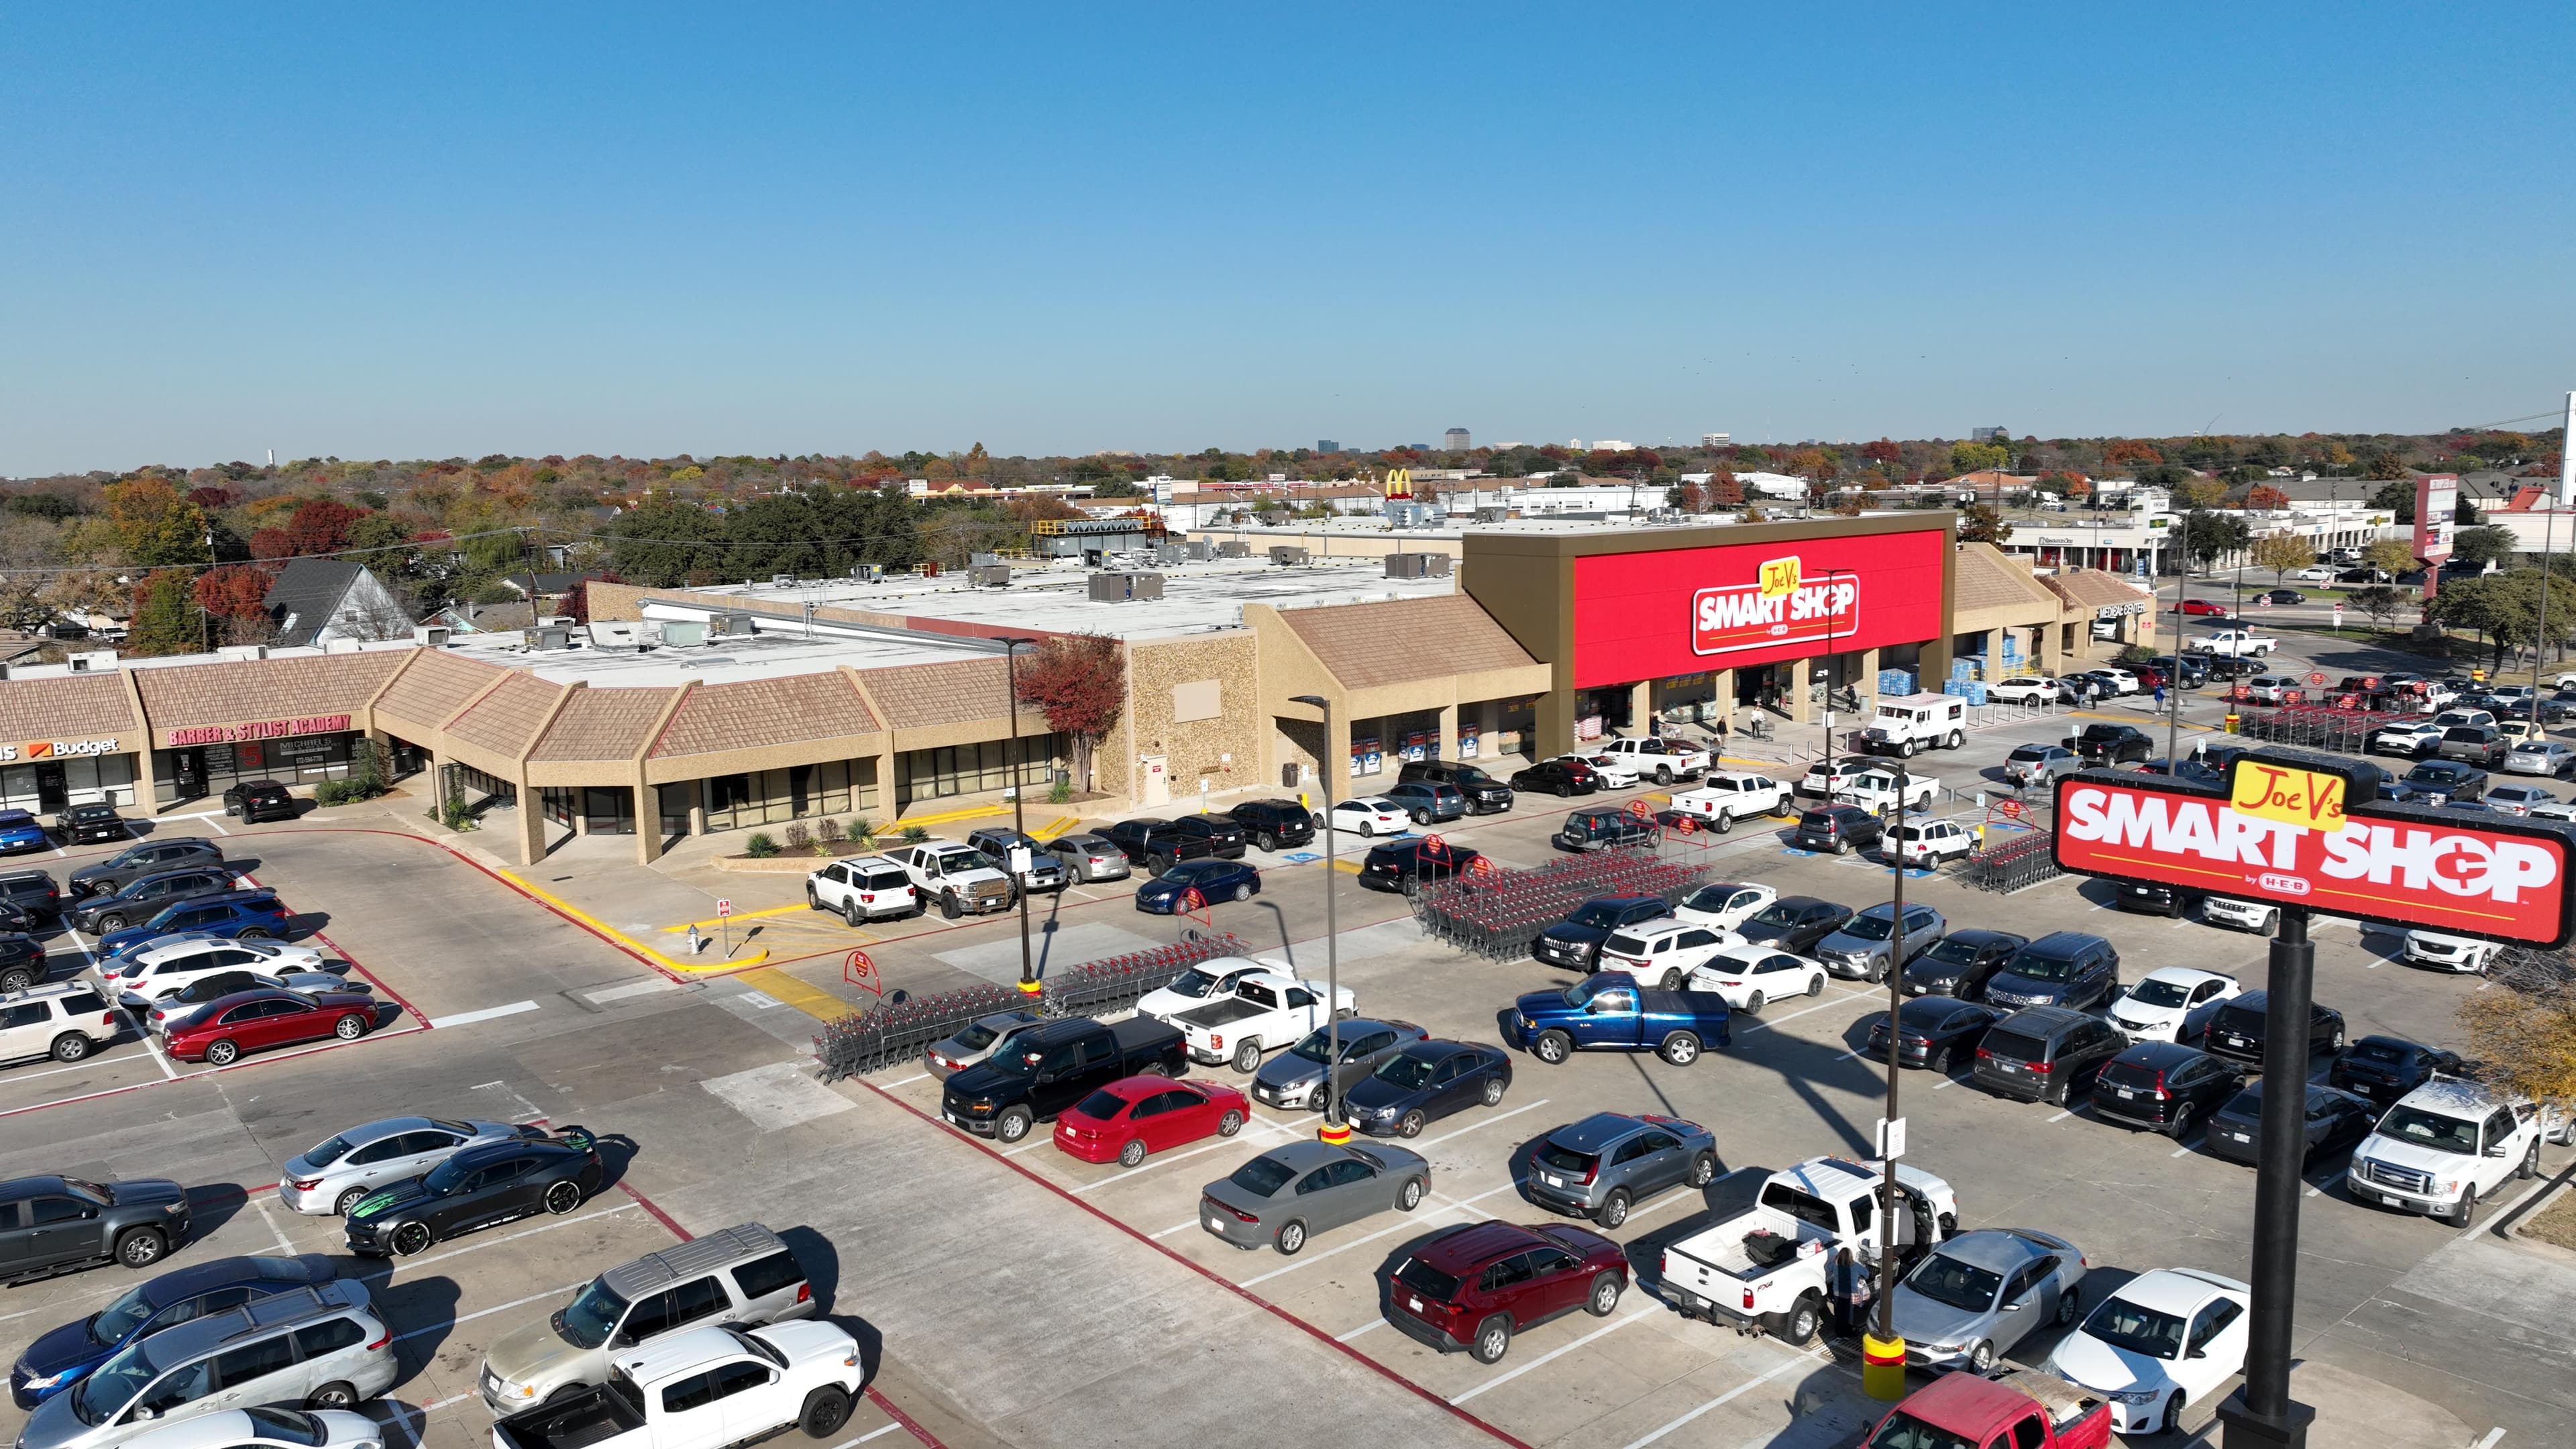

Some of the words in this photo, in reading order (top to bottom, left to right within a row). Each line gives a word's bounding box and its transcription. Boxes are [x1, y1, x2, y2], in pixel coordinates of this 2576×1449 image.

[1699, 592, 1787, 631] SMART
[1790, 583, 1855, 621] SHOP
[2099, 606, 2123, 618] MEDICAL
[2124, 602, 2145, 615] CENTER
[168, 727, 222, 746] BARBER
[224, 727, 235, 741] &
[237, 720, 289, 740] STYLIST
[290, 714, 350, 735] ACADEMY
[53, 738, 119, 757] Budget
[280, 737, 332, 749] MICHAEL'S
[2239, 766, 2302, 810] Joe
[2306, 772, 2343, 820] V's
[2066, 789, 2309, 871] SMART
[2320, 820, 2557, 903] SHOP
[2245, 874, 2257, 885] by
[2266, 877, 2303, 890] H-E-B
